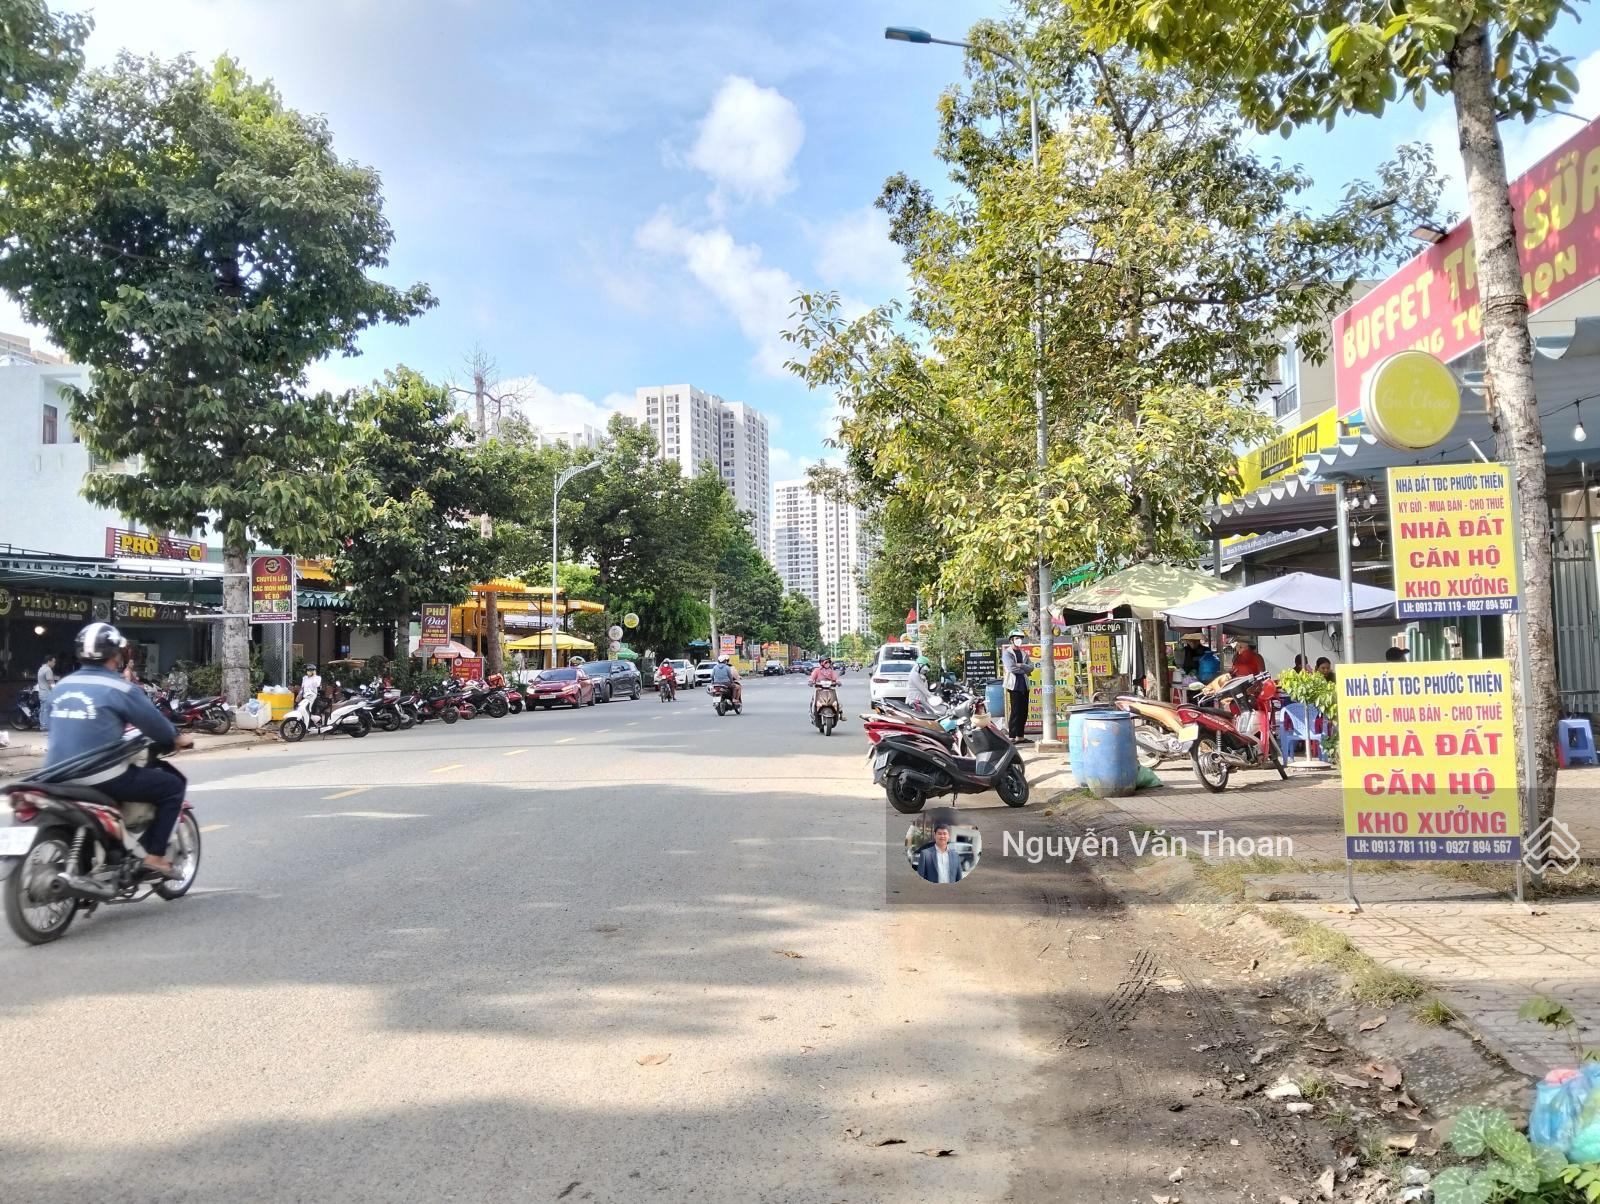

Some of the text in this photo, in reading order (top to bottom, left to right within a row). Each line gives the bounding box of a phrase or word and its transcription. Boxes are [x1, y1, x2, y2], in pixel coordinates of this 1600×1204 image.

[1343, 268, 1435, 368] BUFFET
[1396, 472, 1505, 493] NHÀ ĐẤT TĐC PHƯỚC THIỆN
[1429, 500, 1446, 512] MUA
[1447, 498, 1463, 511] BÁN
[1469, 499, 1485, 510] CHO
[1486, 496, 1505, 509] THUÊ
[1401, 513, 1505, 539] NHÀ ĐẤT
[1409, 545, 1500, 569] CĂN HỘ
[1405, 573, 1509, 598] KHO XƯỞNG
[1403, 603, 1415, 613] LH:
[1415, 601, 1433, 612] 0913
[1434, 601, 1447, 612] 781
[1448, 600, 1461, 611] 119
[1467, 599, 1484, 611] 0927
[1500, 598, 1514, 609] 567
[1345, 670, 1503, 697] NHÀ ĐẤT TĐC PHƯỚC THIỆN
[1349, 704, 1362, 723] KÝ
[1392, 707, 1416, 722] MUA
[1418, 703, 1441, 722] BÁN
[1452, 705, 1473, 721] CHO
[1476, 702, 1503, 720] THUÊ
[1351, 725, 1503, 757] NHÀ ĐẤT
[1363, 767, 1496, 800] CĂN HỘ
[1357, 804, 1507, 834] KHO XƯỞNG
[1354, 840, 1369, 853] LH:
[1371, 840, 1395, 854] 0913
[1397, 840, 1415, 853] 781
[1417, 840, 1437, 853] 119
[1446, 840, 1470, 853] 0927
[1473, 840, 1491, 853] 894
[1493, 840, 1512, 853] 567
